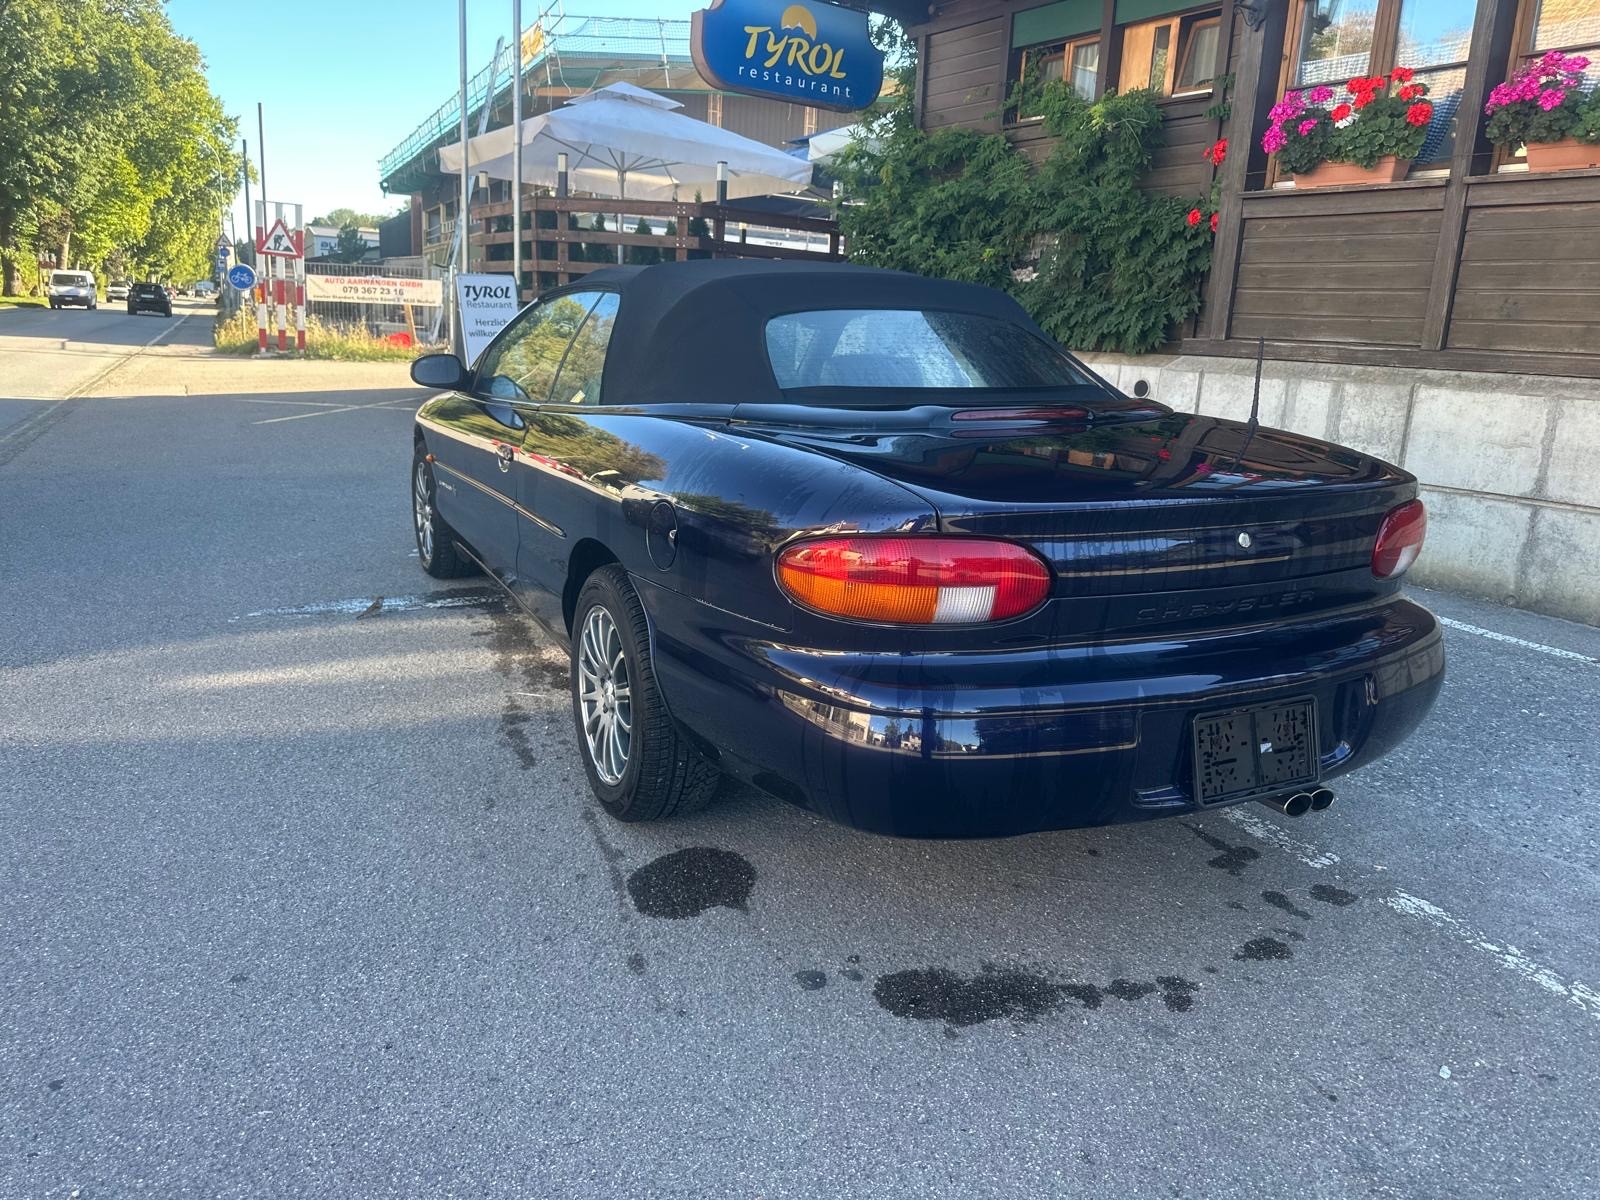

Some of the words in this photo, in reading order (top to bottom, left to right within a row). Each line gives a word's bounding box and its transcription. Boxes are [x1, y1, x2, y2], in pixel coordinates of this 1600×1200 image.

[743, 25, 847, 79] TYROL
[738, 65, 851, 98] restaurant
[324, 277, 345, 285] AUTO
[347, 278, 397, 287] AARWANGEN
[399, 280, 423, 288] GMBH
[342, 286, 359, 294] 079
[361, 287, 377, 295] 367
[379, 287, 391, 295] 23
[464, 285, 511, 301] TYROL
[467, 300, 512, 309] Restaurant
[1136, 589, 1315, 621] CHRYSLER
